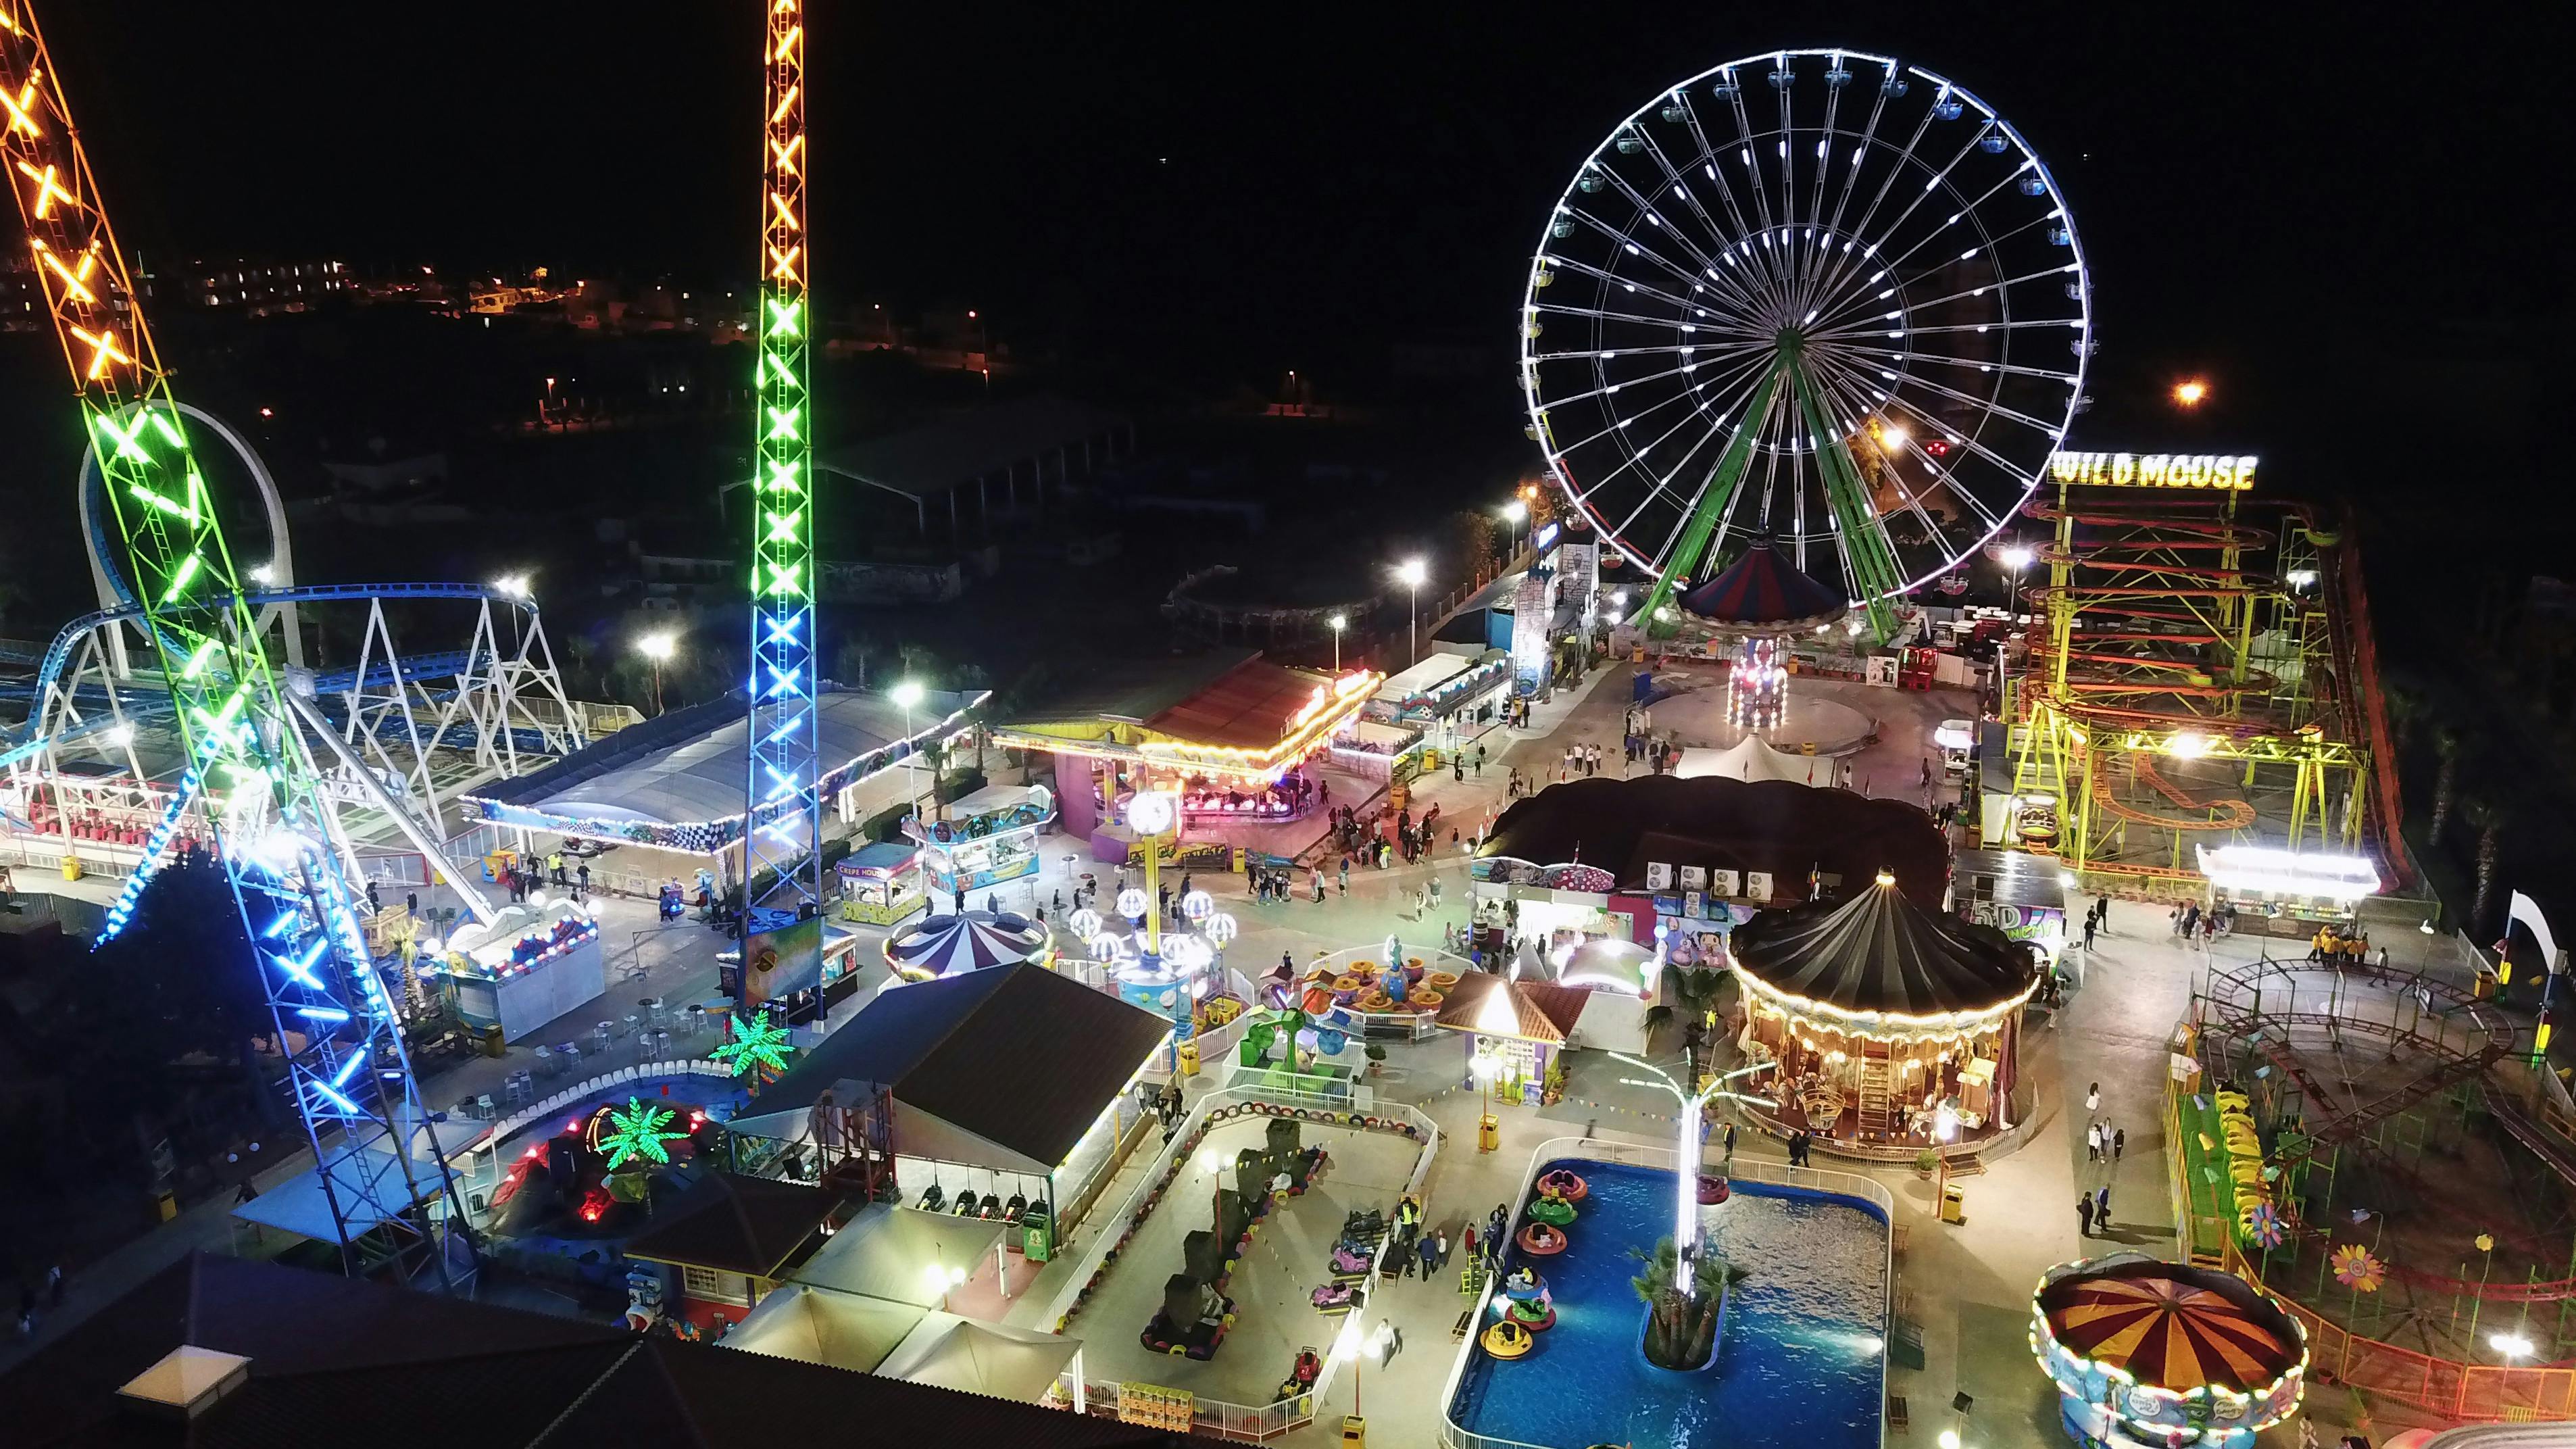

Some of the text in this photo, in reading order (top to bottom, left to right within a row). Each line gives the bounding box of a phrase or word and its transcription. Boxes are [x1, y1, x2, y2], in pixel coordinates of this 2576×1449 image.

[2052, 451, 2258, 490] WILD MOUSE
[839, 866, 881, 877] CREPE HOUS
[1975, 902, 2021, 931] 5D
[2006, 918, 2056, 940] INEMA
